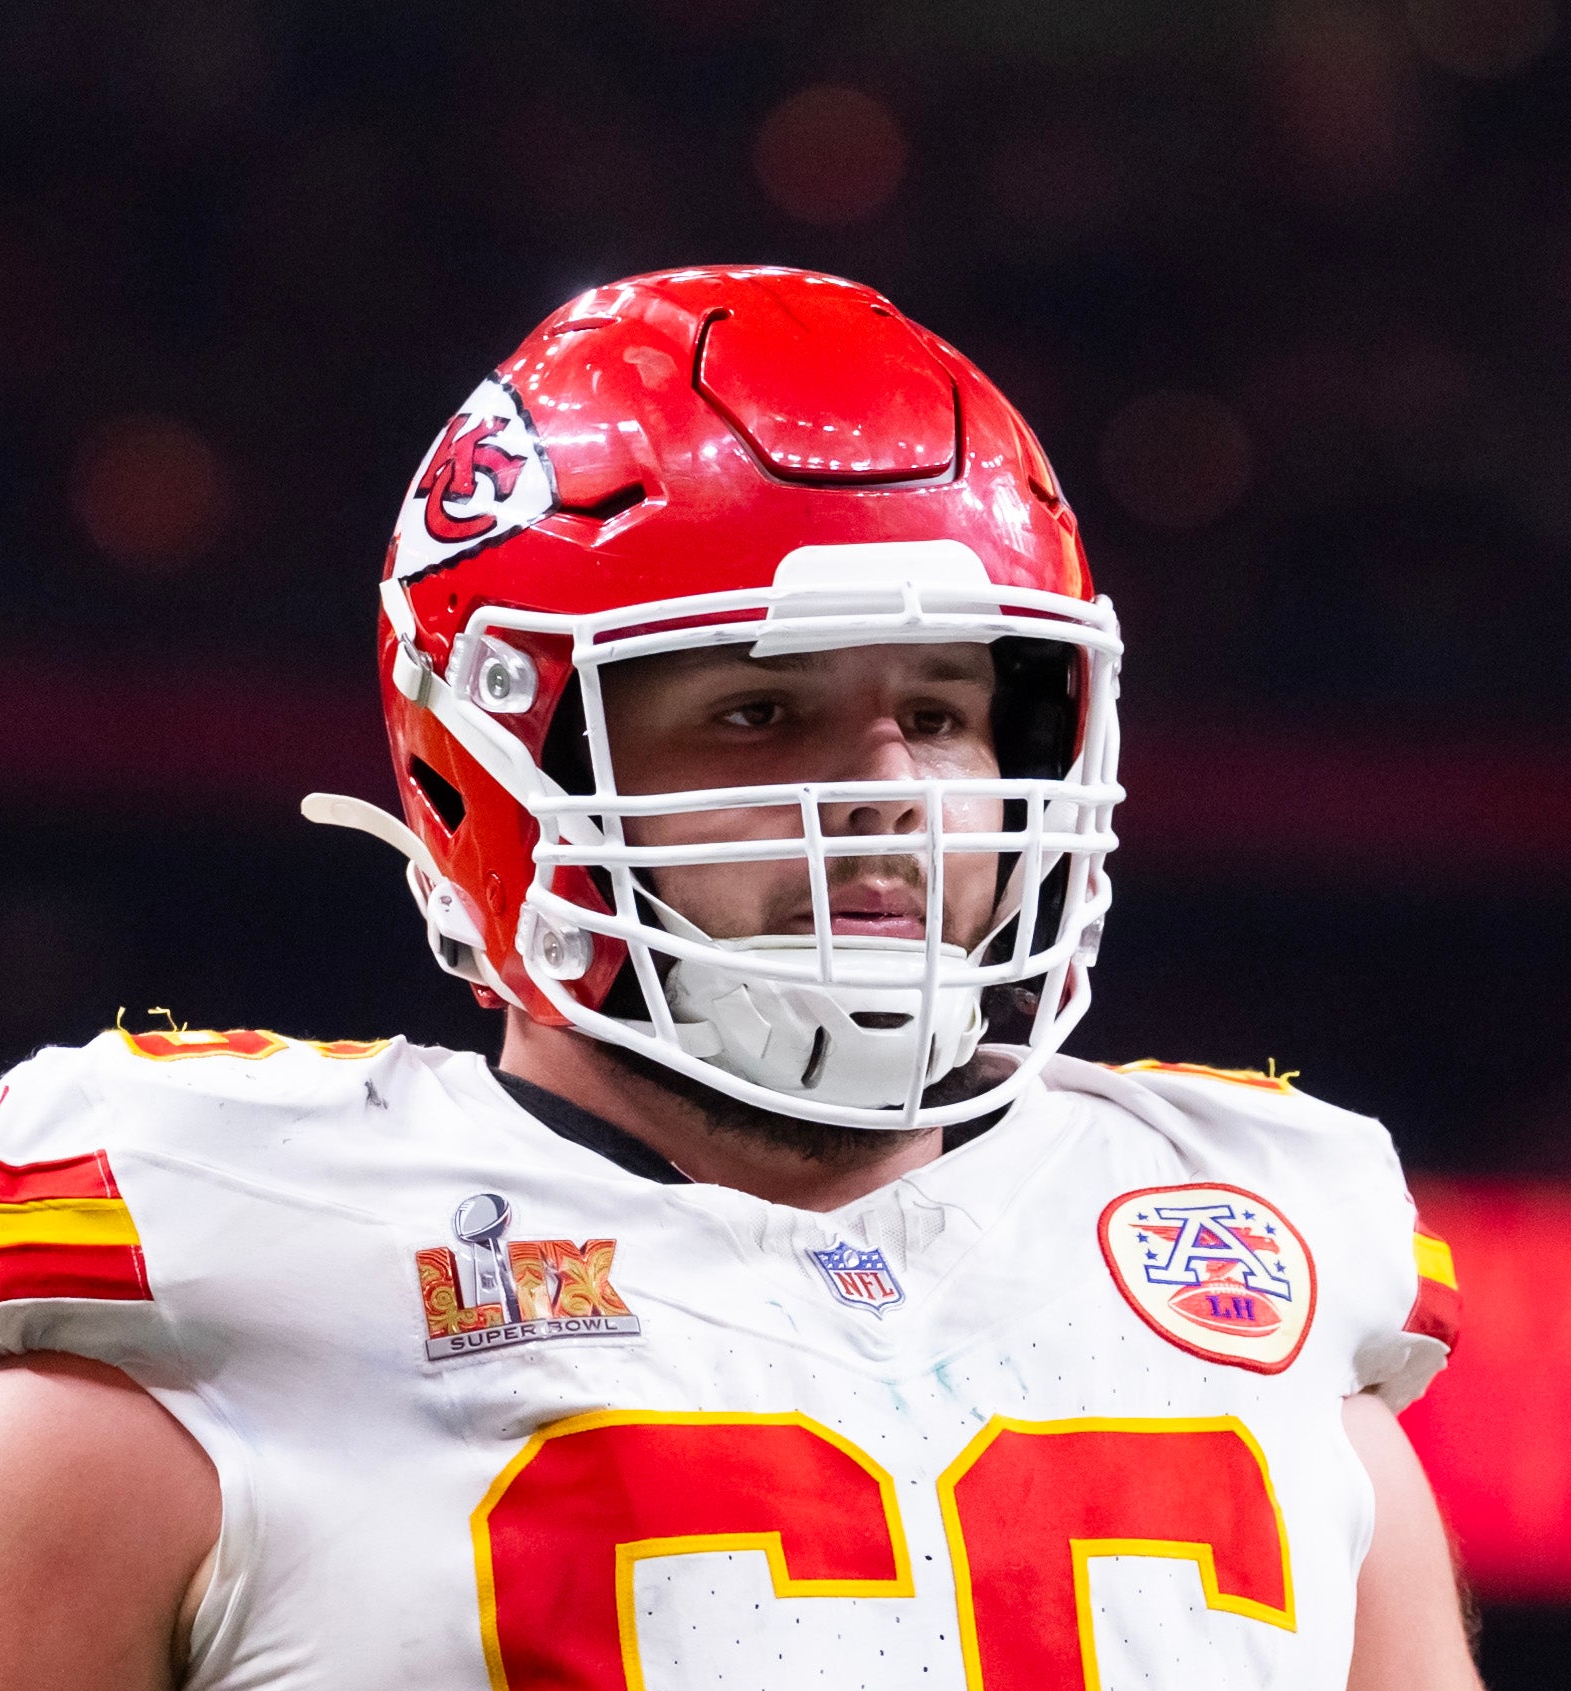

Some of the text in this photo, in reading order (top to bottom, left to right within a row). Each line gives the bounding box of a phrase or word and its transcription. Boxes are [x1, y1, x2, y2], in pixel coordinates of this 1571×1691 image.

[834, 1272, 894, 1300] NFL
[1206, 1295, 1255, 1321] LH
[450, 1318, 618, 1350] SUPER BOWL
